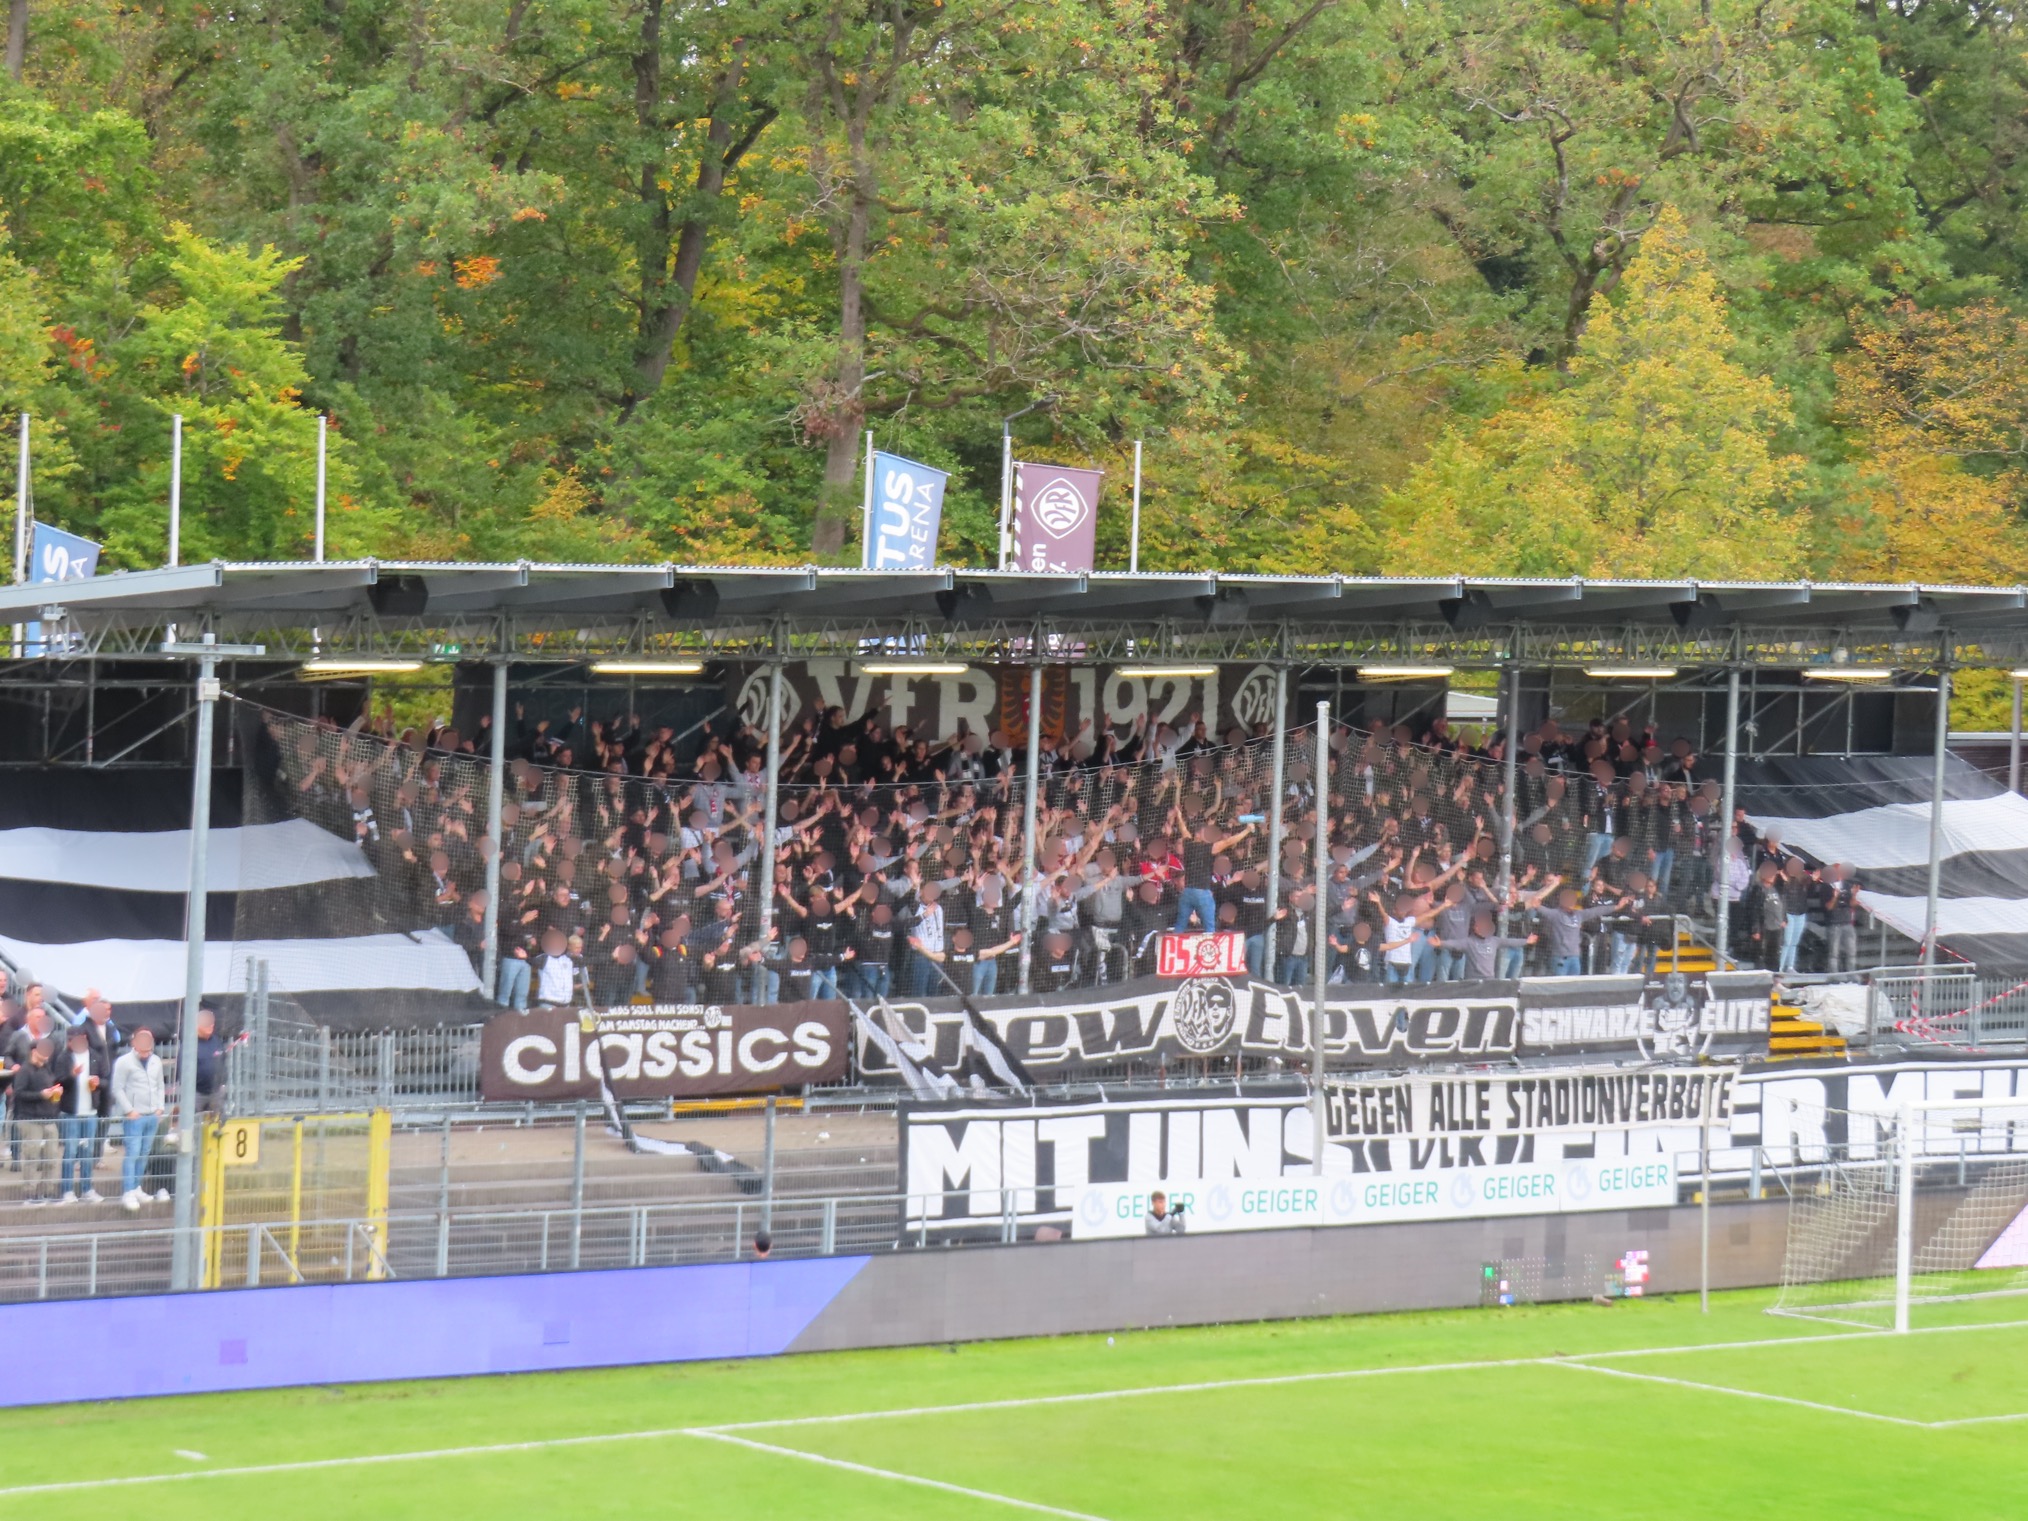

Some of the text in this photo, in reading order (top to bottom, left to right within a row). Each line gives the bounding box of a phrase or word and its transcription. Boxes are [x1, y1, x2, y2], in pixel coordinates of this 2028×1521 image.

[876, 470, 913, 568] TUS
[909, 483, 935, 570] RENA
[806, 660, 1224, 756] VfR 1921
[1243, 980, 1517, 1053] Eleven
[1523, 1004, 1656, 1046] SCHWARZE
[1701, 1000, 1769, 1032] ELITE
[503, 1015, 831, 1084] classics
[1325, 1071, 1733, 1136] GEGEN ALLE STADIONVERBOTE
[236, 1127, 247, 1158] 8
[907, 1114, 1106, 1218] MIT
[1241, 1188, 1319, 1213] GEIGER
[1364, 1181, 1439, 1207] GEIGER
[1483, 1173, 1556, 1200] GEIGER
[1599, 1164, 1669, 1191] GEIGER
